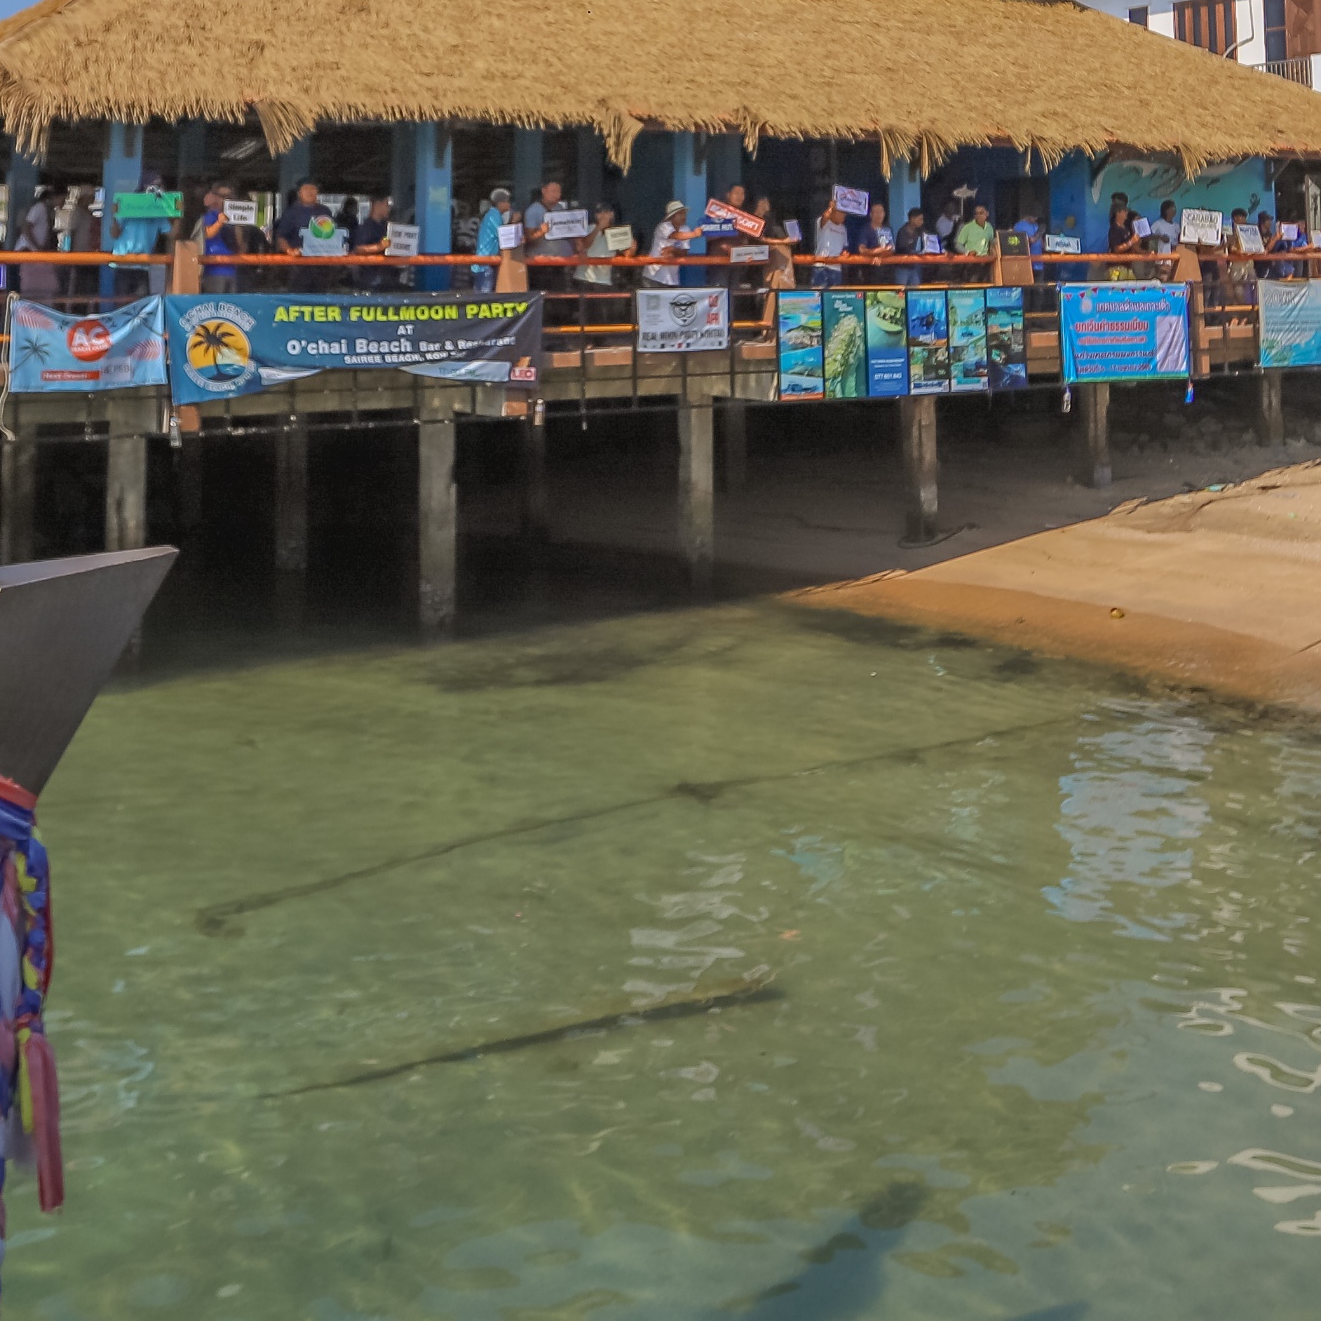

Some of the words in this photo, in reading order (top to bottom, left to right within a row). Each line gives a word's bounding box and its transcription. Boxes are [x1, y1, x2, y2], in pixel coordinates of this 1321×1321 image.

[228, 203, 254, 212] Simple
[275, 306, 342, 322] AFTER
[349, 305, 459, 322] FULLMOON
[466, 302, 528, 319] PARTY
[71, 326, 105, 347] AC
[397, 325, 414, 336] AT
[286, 339, 347, 355] O'chai
[355, 338, 412, 353] Beach
[419, 341, 441, 352] Bar
[444, 340, 455, 351] &
[344, 354, 382, 364] SAIREE
